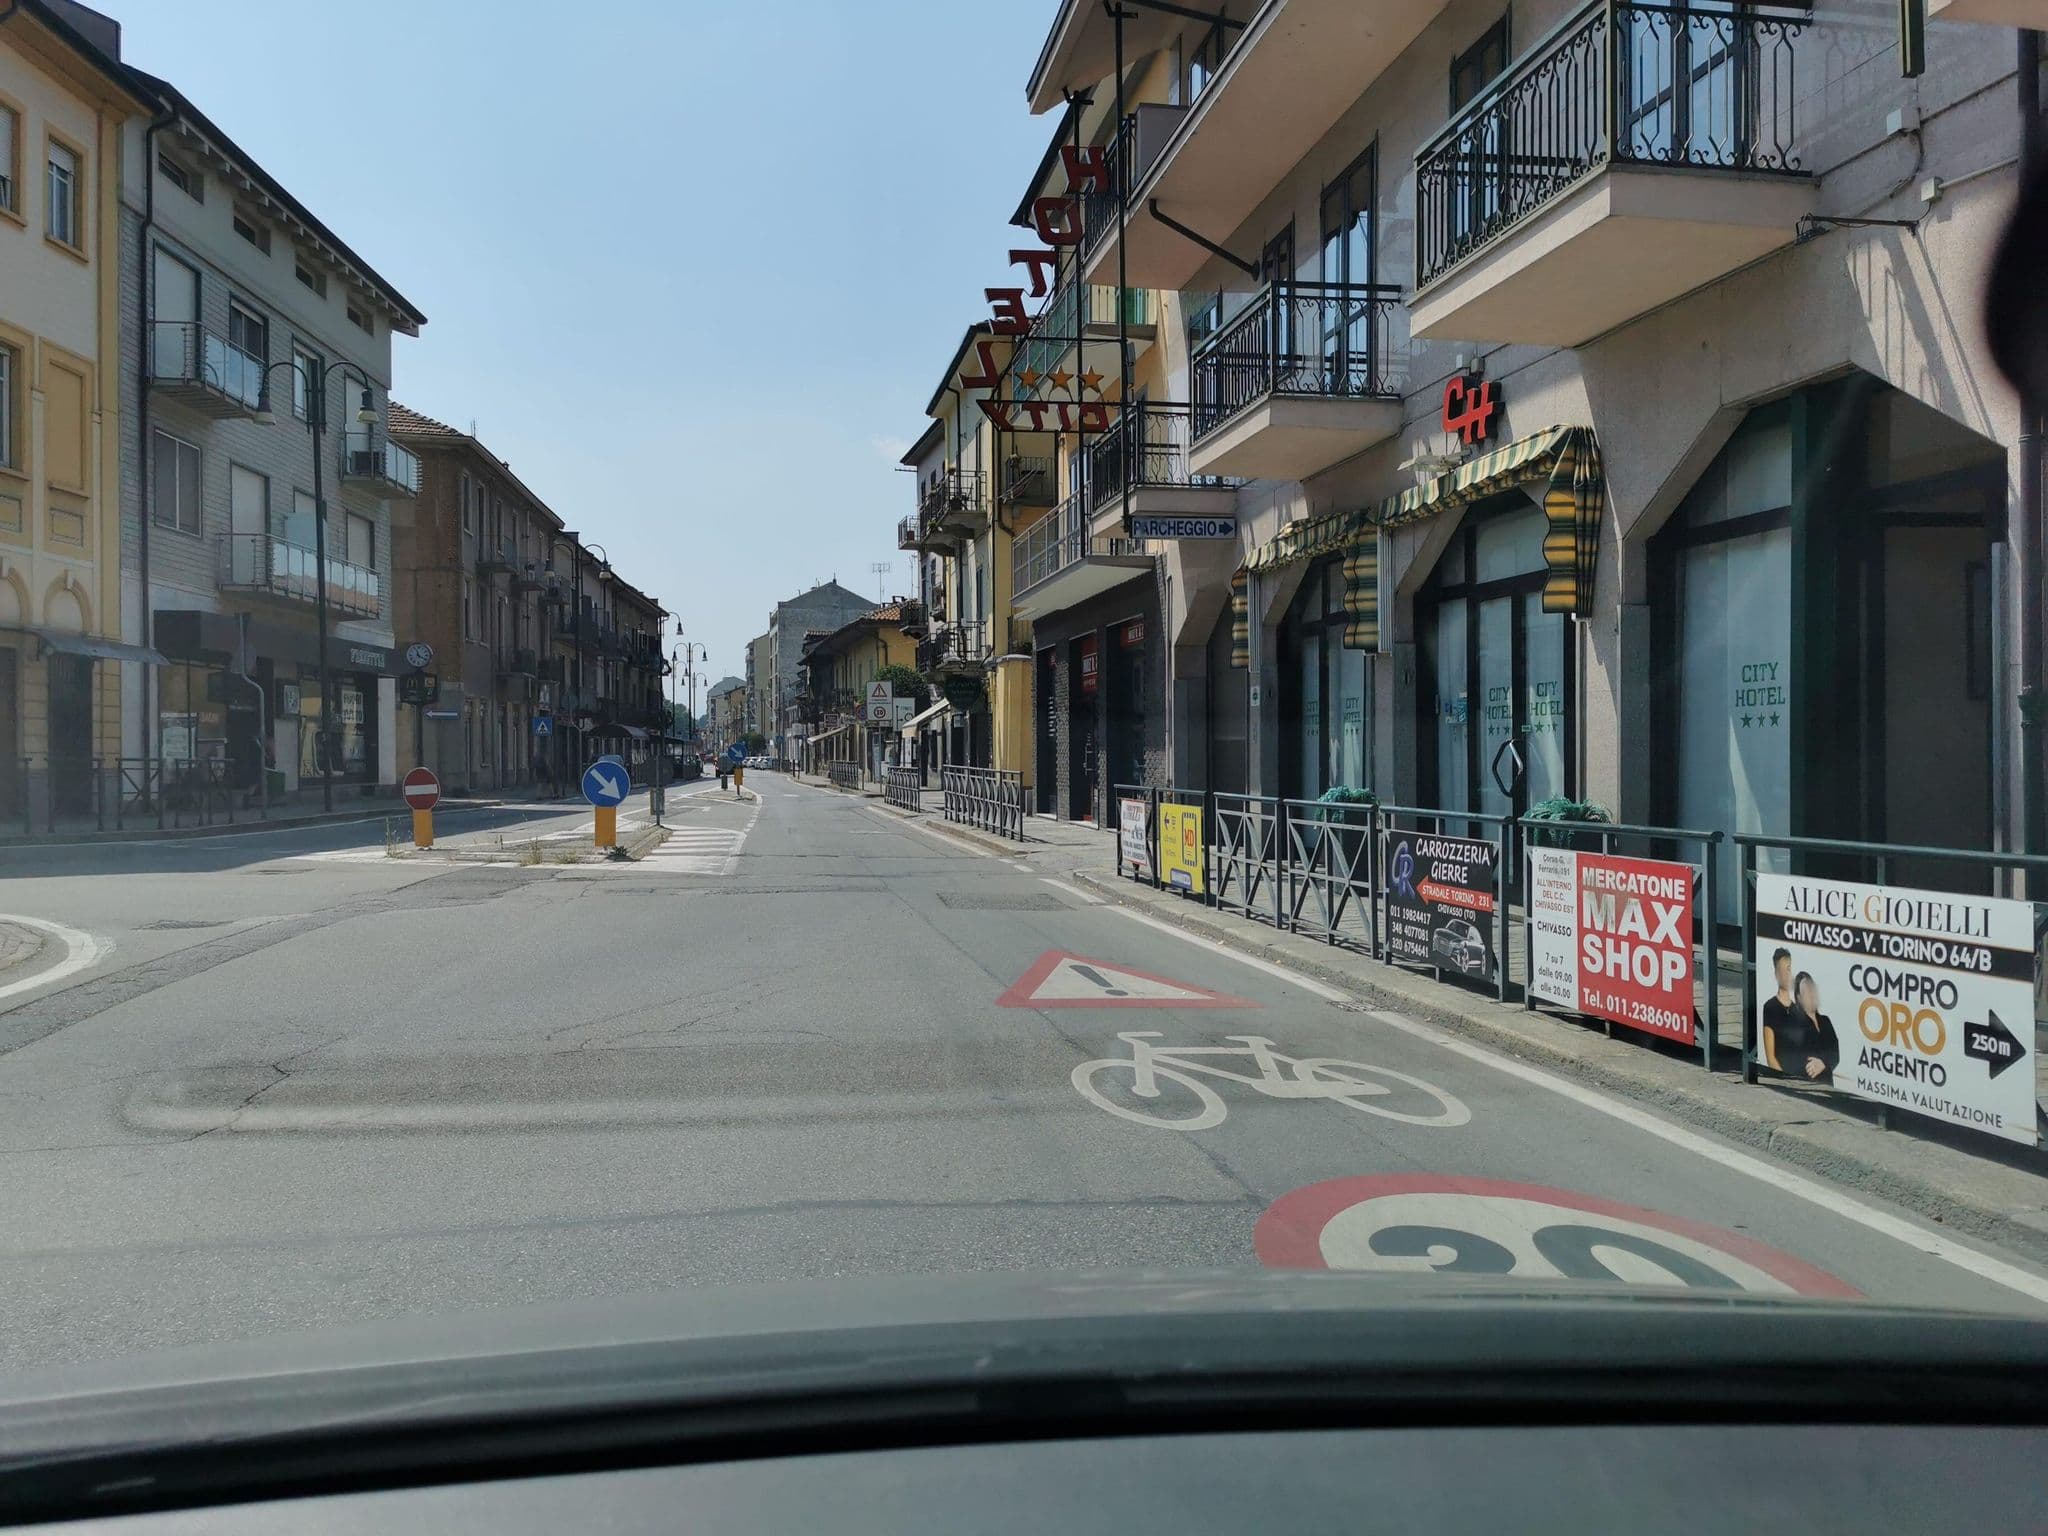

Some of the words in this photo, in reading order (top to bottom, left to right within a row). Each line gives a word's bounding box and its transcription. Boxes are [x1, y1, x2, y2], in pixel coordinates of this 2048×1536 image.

[1133, 520, 1217, 537] PARCHEGGIO
[1742, 662, 1778, 682] CITY
[1489, 686, 1510, 701] CITY
[1736, 687, 1785, 707] HOTEL
[1416, 838, 1490, 866] CARROZZERIA
[1431, 862, 1468, 883] GIERRE
[1583, 866, 1685, 901] MERCATONE
[1422, 886, 1450, 900] STRADALE
[1479, 896, 1489, 907] 231
[1543, 890, 1552, 899] DEL
[1390, 905, 1400, 918] 011
[1438, 904, 1463, 917] CHIVASSO
[1464, 908, 1476, 922] (TO)
[1535, 900, 1562, 912] CHIVASSO
[1563, 905, 1574, 914] EST
[1785, 885, 1857, 920] ALICE
[1864, 894, 1992, 938] GIOIELLI
[1537, 921, 1571, 937] CHIVASSO
[1583, 890, 1686, 948] MAX
[1582, 934, 1687, 993] SHOP
[1881, 935, 1947, 965] TORINO
[1950, 947, 1992, 972] 64/B
[1555, 971, 1572, 983] 09.00
[1849, 964, 1958, 1011] COMPRO
[1553, 986, 1570, 999] 20.00
[1584, 988, 1603, 1009] Tel.
[1606, 994, 1688, 1035] 011.2386901
[1858, 998, 1946, 1056] ORO
[1858, 1046, 1947, 1088] ARGENTO
[1857, 1077, 1908, 1103] MASSIMA
[1912, 1085, 2002, 1129] VALUTAZIONE
